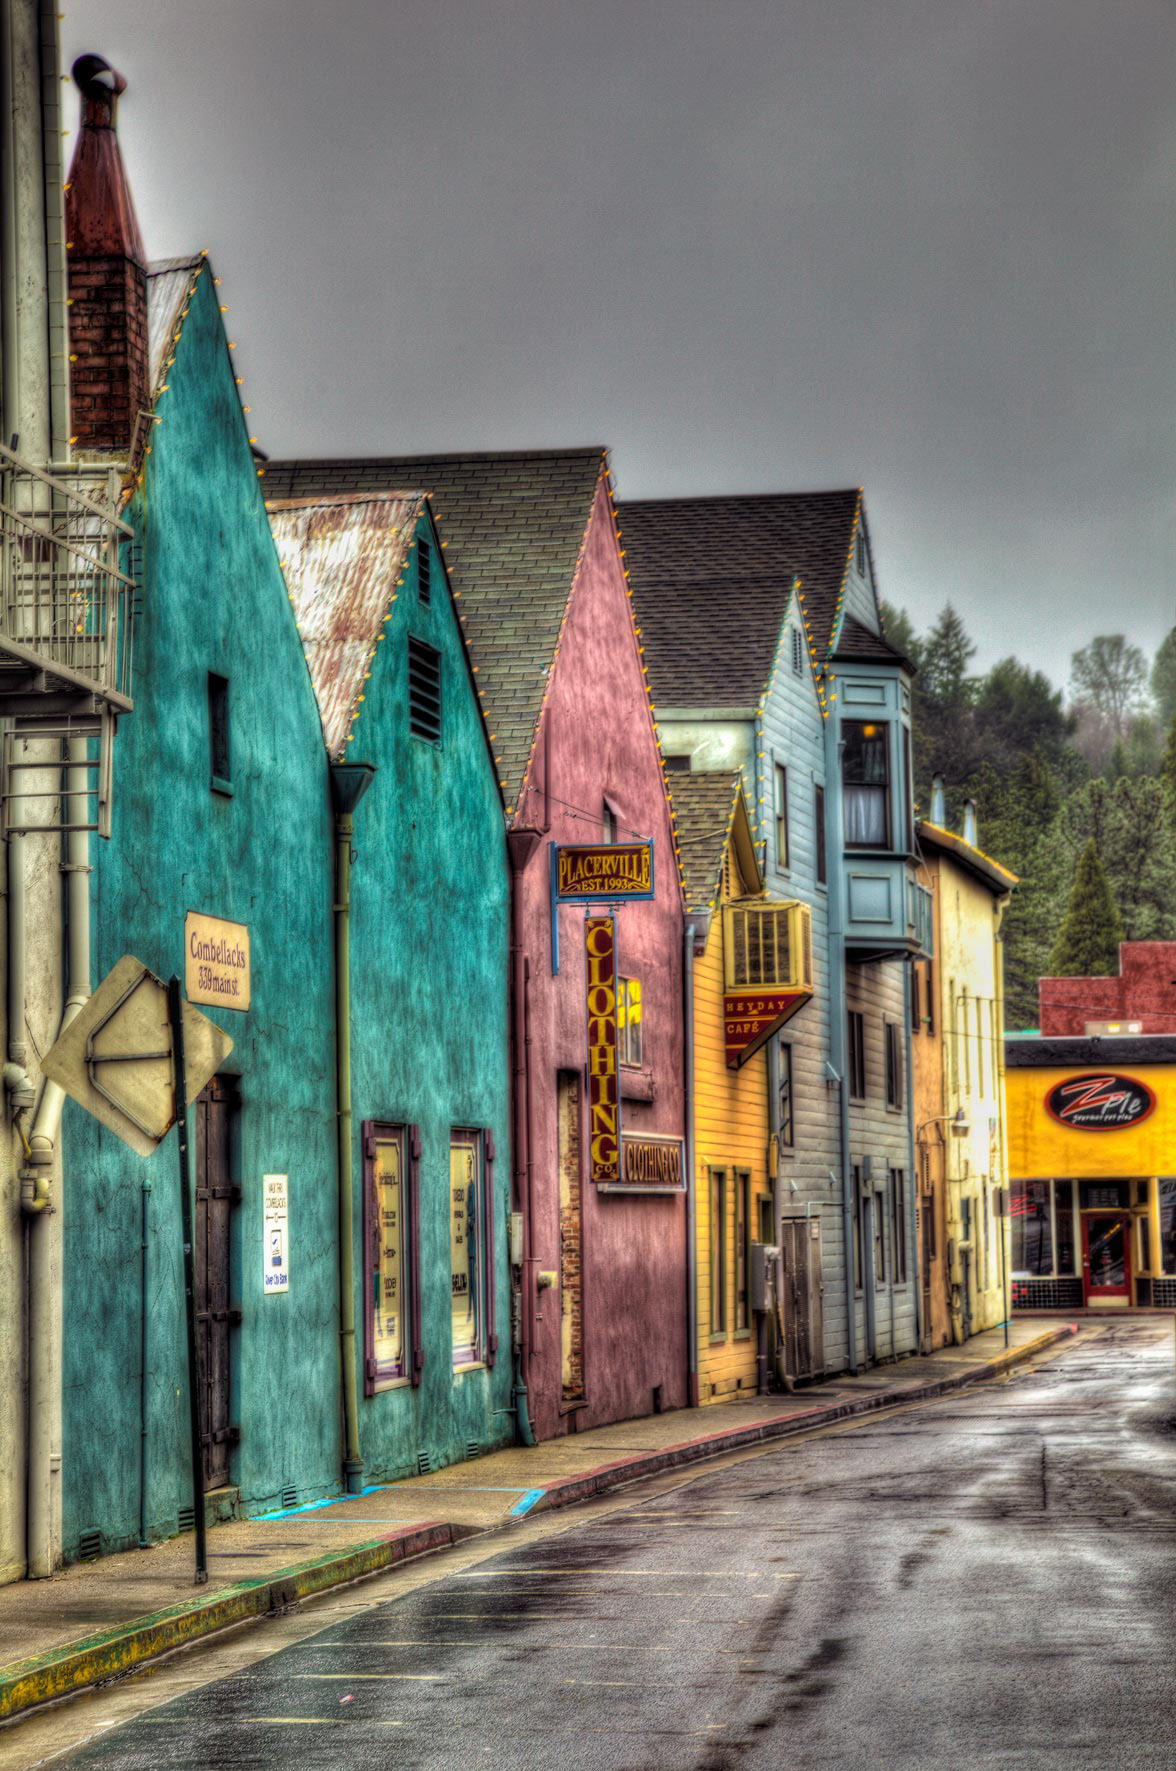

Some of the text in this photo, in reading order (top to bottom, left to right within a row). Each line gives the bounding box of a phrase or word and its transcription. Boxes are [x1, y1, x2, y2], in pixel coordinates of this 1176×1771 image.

[559, 854, 651, 890] PLACERVILLE
[190, 932, 245, 968] Combellacks
[199, 966, 212, 990] 339
[213, 973, 231, 994] main
[726, 1000, 785, 1012] HEYDAY
[727, 1021, 760, 1034] CAFÉ
[586, 926, 619, 1166] CLOTHING
[595, 1164, 616, 1174] CO.
[627, 1144, 668, 1182] CLOTHING
